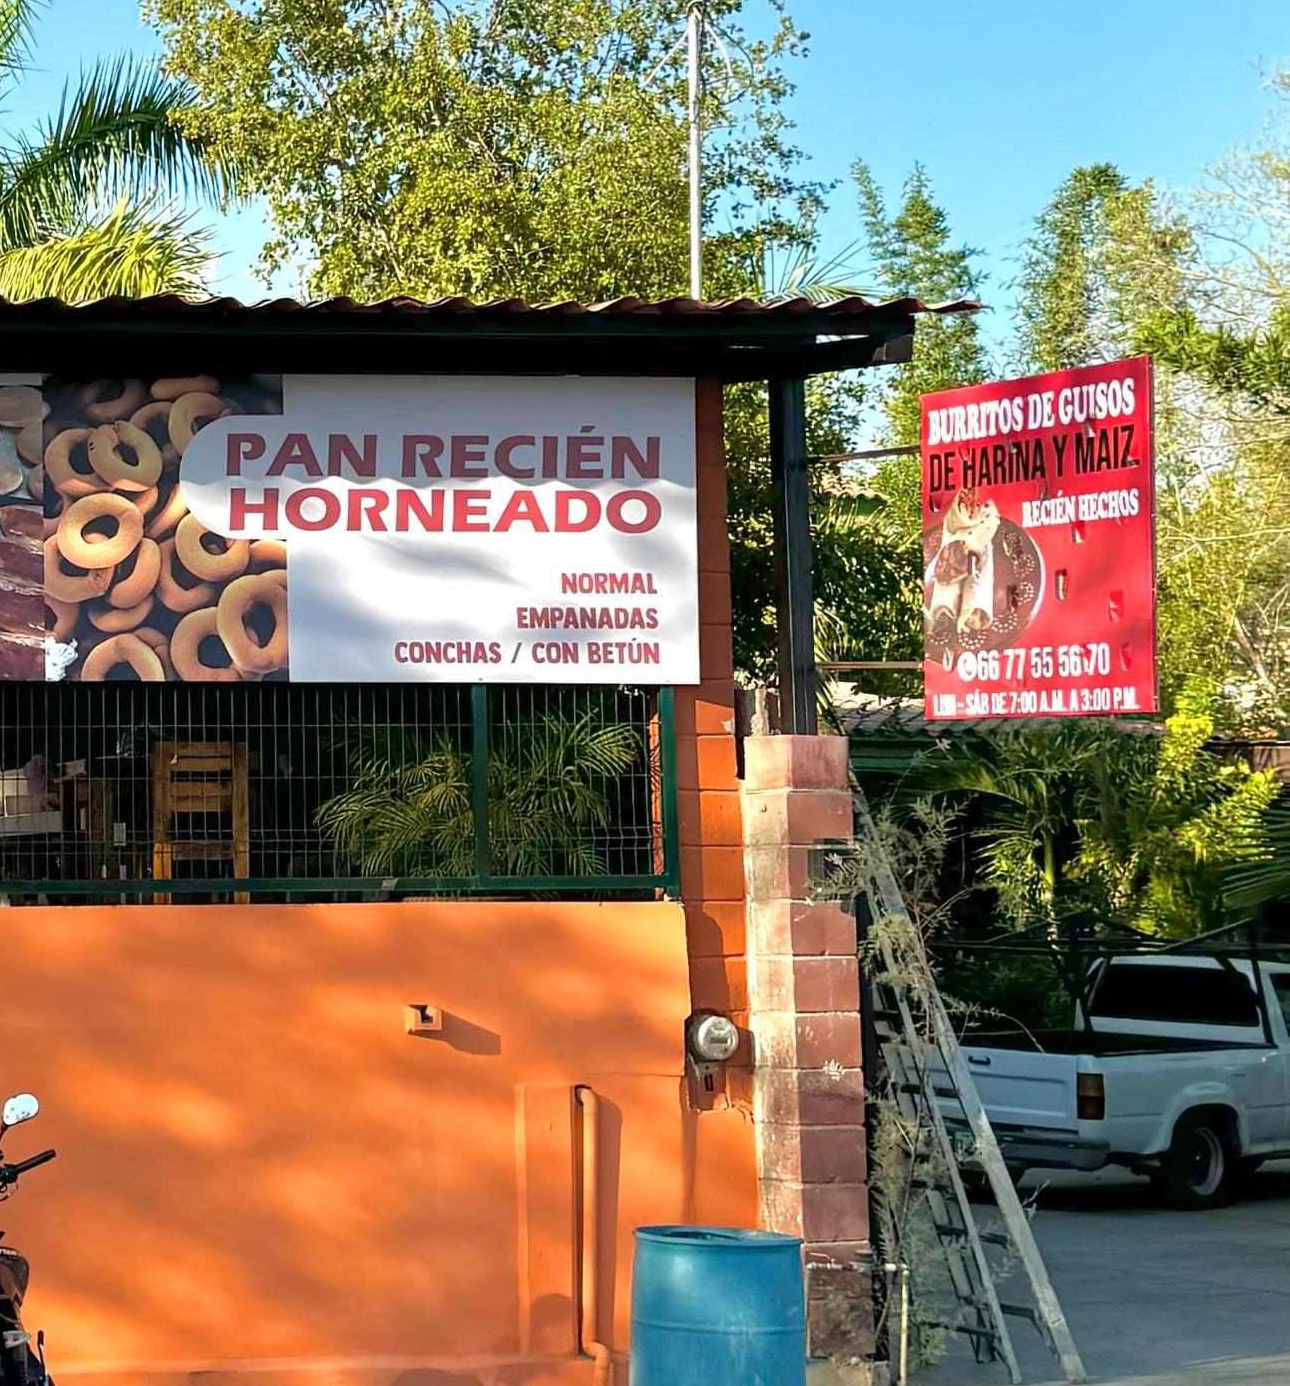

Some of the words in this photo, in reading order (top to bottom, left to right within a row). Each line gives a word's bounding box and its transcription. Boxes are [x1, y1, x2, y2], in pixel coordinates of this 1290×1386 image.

[928, 396, 1024, 445] BURRITOS
[1028, 391, 1055, 430] DE
[1059, 378, 1135, 425] GUISOS
[226, 433, 377, 477] PAN
[401, 425, 660, 479] RECIÉN
[930, 452, 955, 492] DE
[963, 438, 1046, 490] HARINA
[1052, 434, 1068, 477] Y
[1075, 424, 1140, 474] MAIZ
[229, 487, 662, 534] HORNEADO
[1022, 490, 1078, 528] RECIÉN
[1078, 488, 1139, 521] HECHOS
[561, 572, 658, 595] NORMAL
[516, 607, 659, 630] EMPANADAS
[394, 641, 502, 664] CONCHAS
[511, 642, 521, 664] /
[531, 642, 582, 664] CON
[588, 637, 660, 665] BETÚN
[976, 650, 1000, 680] 66
[1004, 648, 1025, 679] 77
[1030, 647, 1053, 678] 55
[1057, 645, 1082, 677] 56
[1086, 643, 1110, 675] 70
[933, 694, 957, 716] LUN
[965, 689, 989, 715] SÁB
[991, 692, 1007, 714] DE
[1009, 691, 1037, 713] 7:00
[1039, 689, 1067, 712] A.M.
[1069, 689, 1079, 711] A
[1081, 688, 1110, 711] 3:00
[1113, 687, 1140, 709] P.M.
